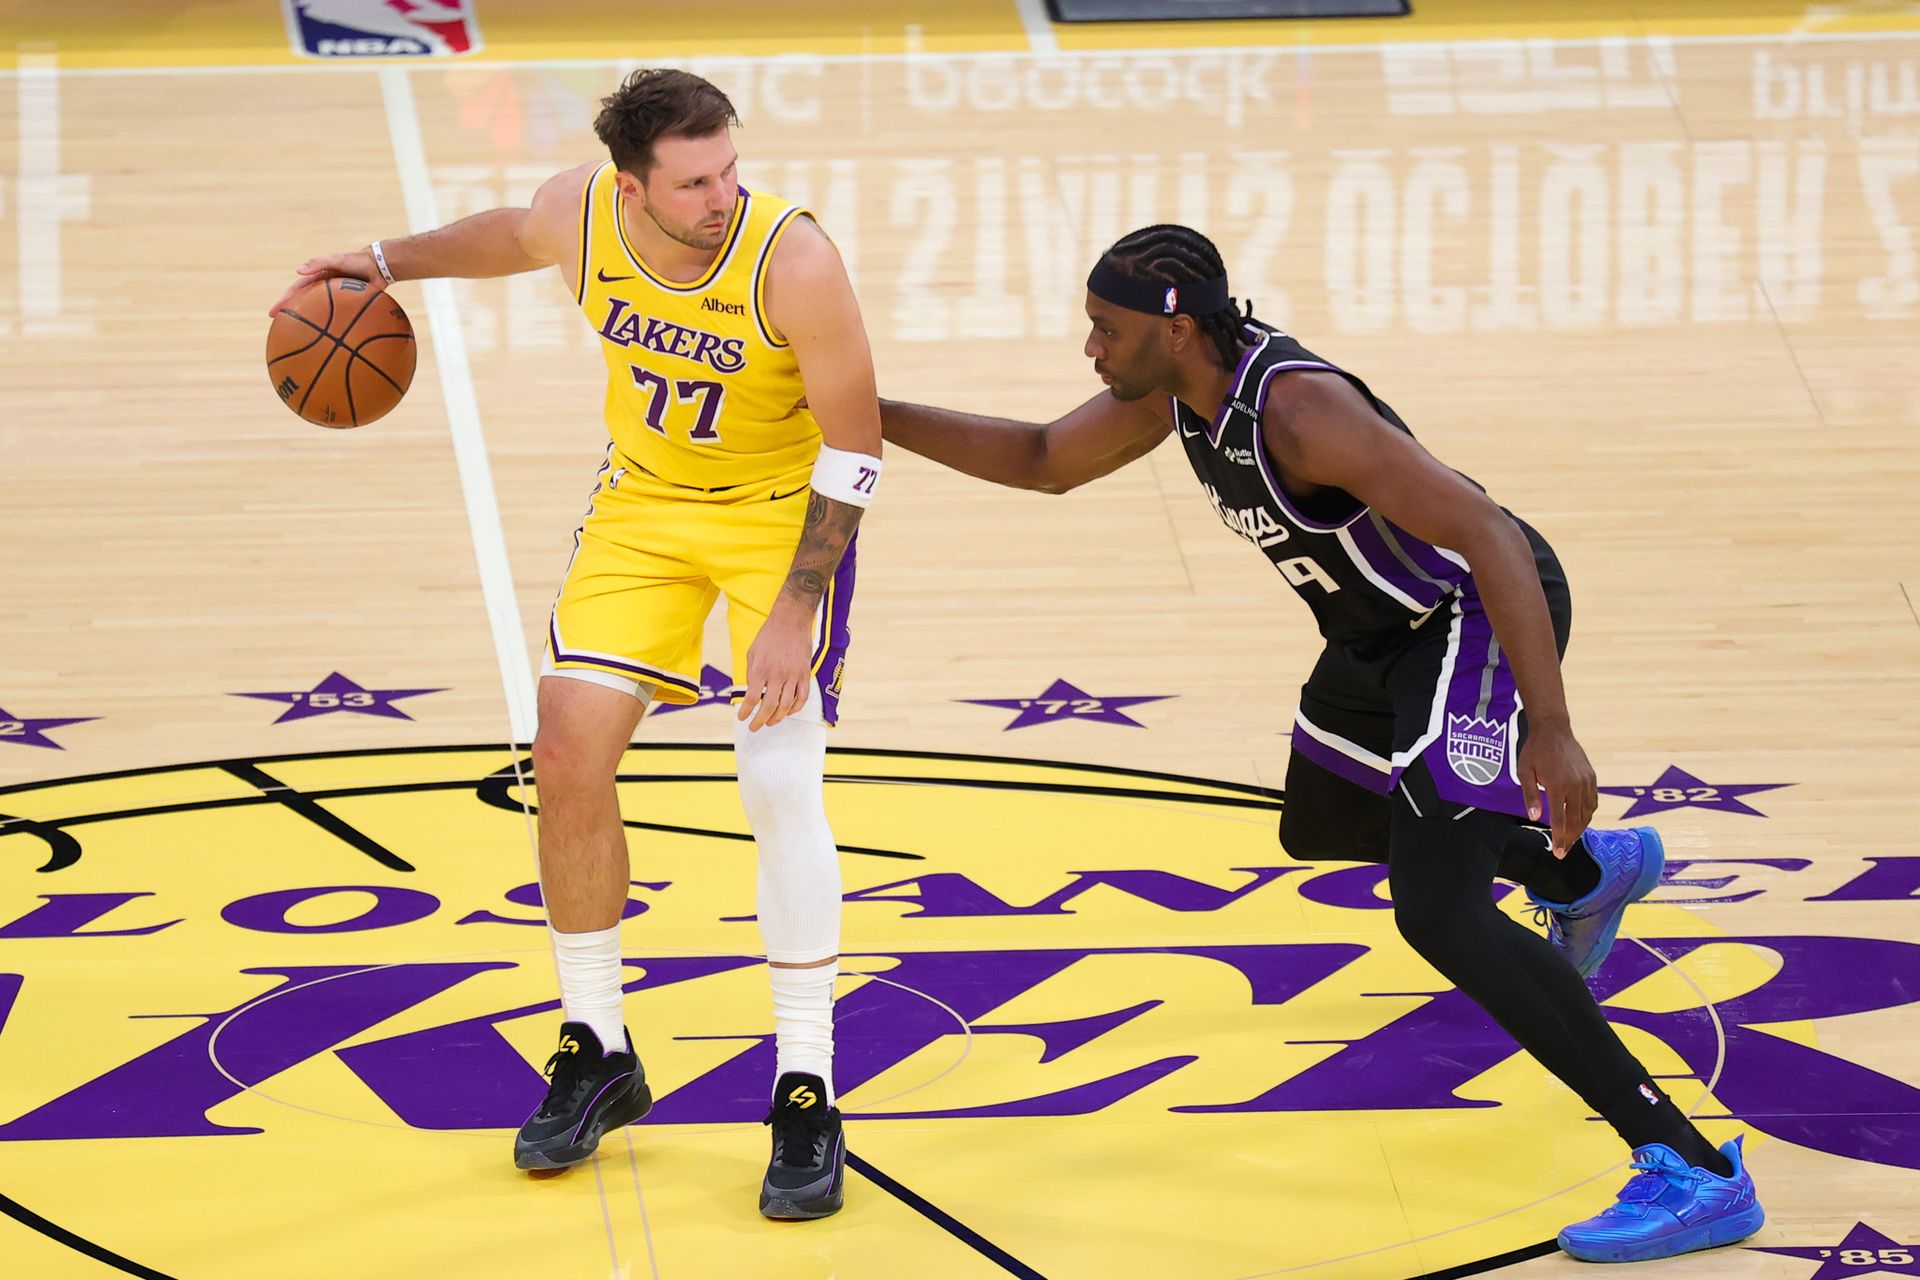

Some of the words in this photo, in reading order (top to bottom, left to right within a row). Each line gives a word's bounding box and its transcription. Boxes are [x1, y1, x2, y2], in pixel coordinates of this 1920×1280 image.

[317, 38, 424, 56] NBA
[701, 297, 746, 316] Albert
[597, 297, 747, 374] LAKERS
[629, 363, 727, 442] 77
[852, 466, 879, 494] 77
[291, 691, 376, 708] '53
[1019, 699, 1105, 715] '72
[1451, 731, 1503, 748] SACRAMENTO
[1449, 740, 1502, 764] KINGS
[1633, 787, 1722, 802] '82
[1819, 1248, 1914, 1266] '85
